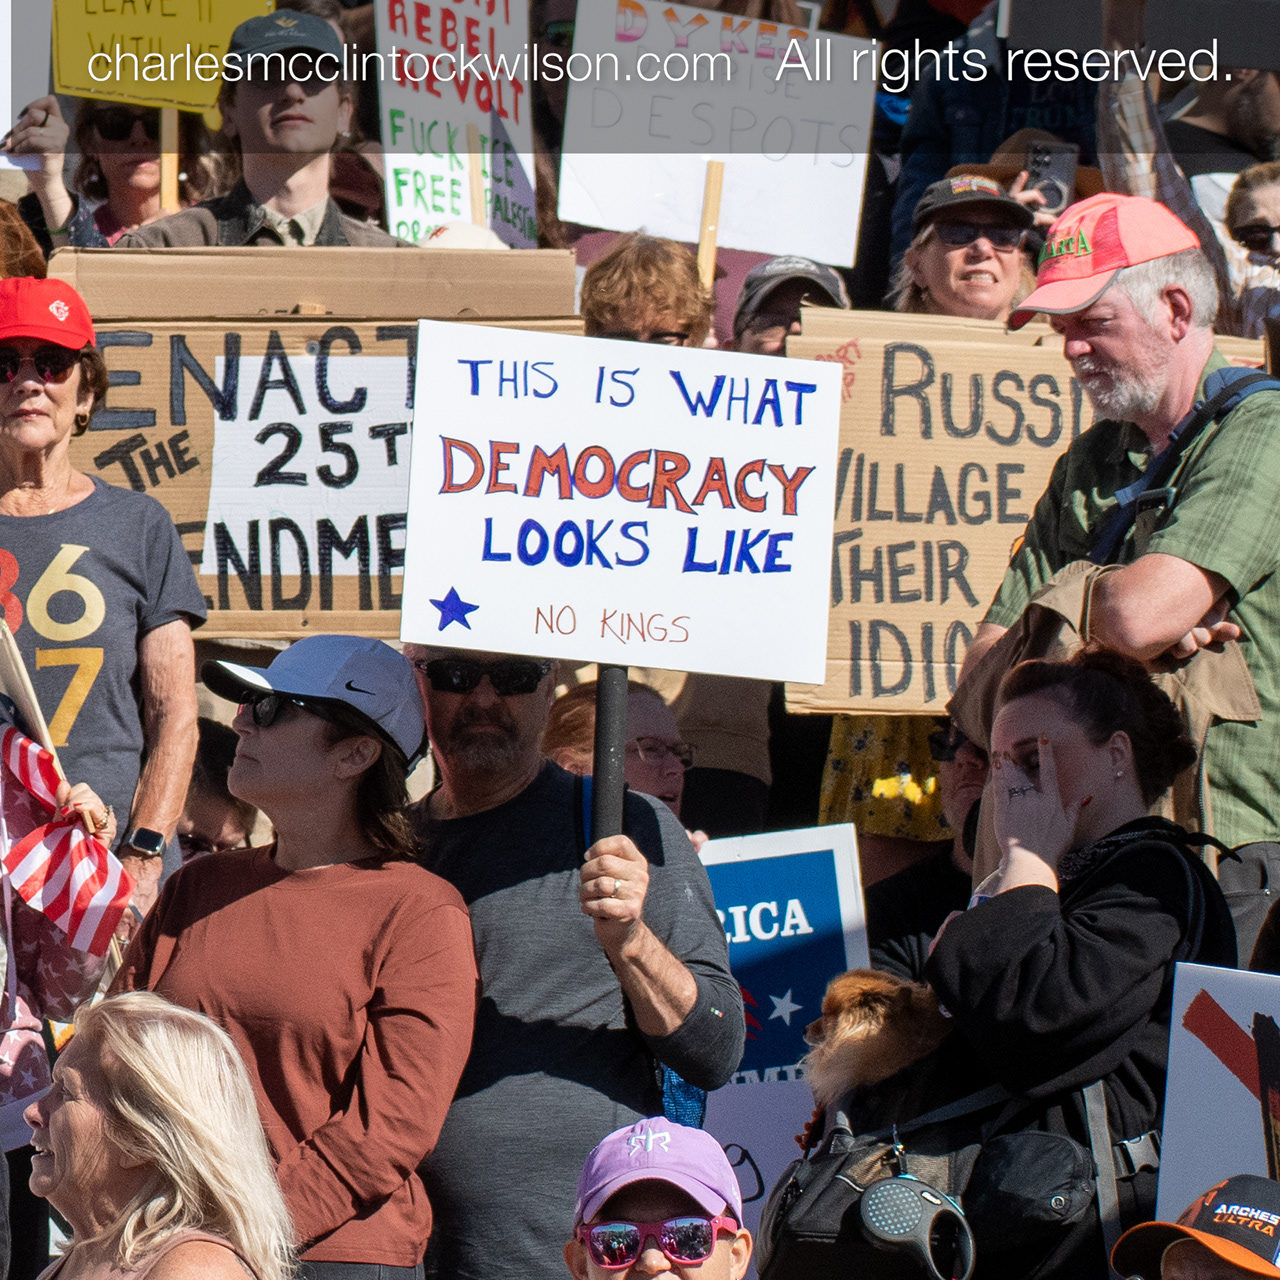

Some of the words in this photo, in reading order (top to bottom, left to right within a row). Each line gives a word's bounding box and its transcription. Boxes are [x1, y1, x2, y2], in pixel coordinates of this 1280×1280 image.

[389, 107, 465, 172] FUCK
[590, 86, 861, 168] DESPOTS
[392, 166, 462, 215] FREE
[457, 358, 559, 400] THIS
[595, 364, 641, 408] IS
[668, 369, 818, 428] WHAT
[93, 429, 201, 493] THE
[437, 434, 817, 516] DEMOCRACY
[481, 517, 650, 570] LOOKS
[681, 526, 794, 575] LIKE
[534, 604, 577, 636] NO
[600, 607, 692, 645] KINGS
[1213, 1202, 1280, 1227] ARCHES
[1213, 1214, 1275, 1238] ULTRA
